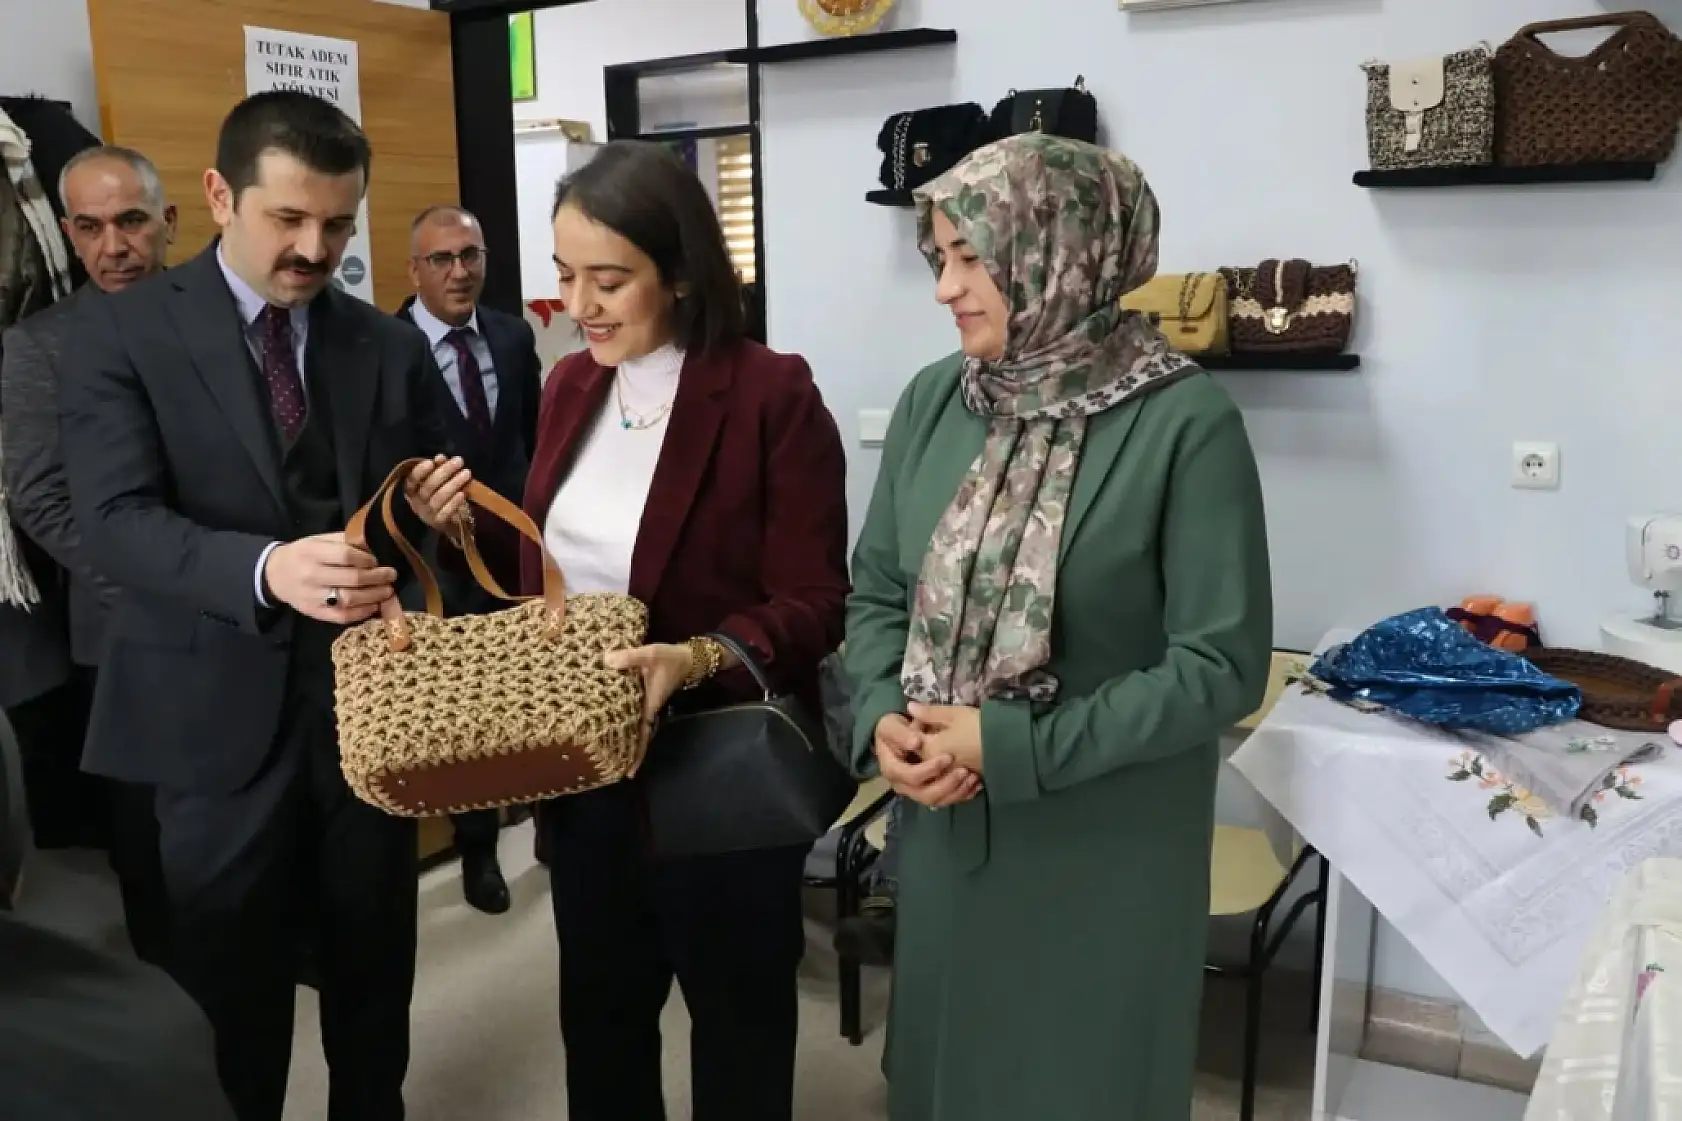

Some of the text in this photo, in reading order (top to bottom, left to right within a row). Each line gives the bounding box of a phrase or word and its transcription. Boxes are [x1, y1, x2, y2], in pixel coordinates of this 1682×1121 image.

[256, 40, 348, 65] TUTAK ADEM
[265, 61, 340, 82] SIFIR ATIK
